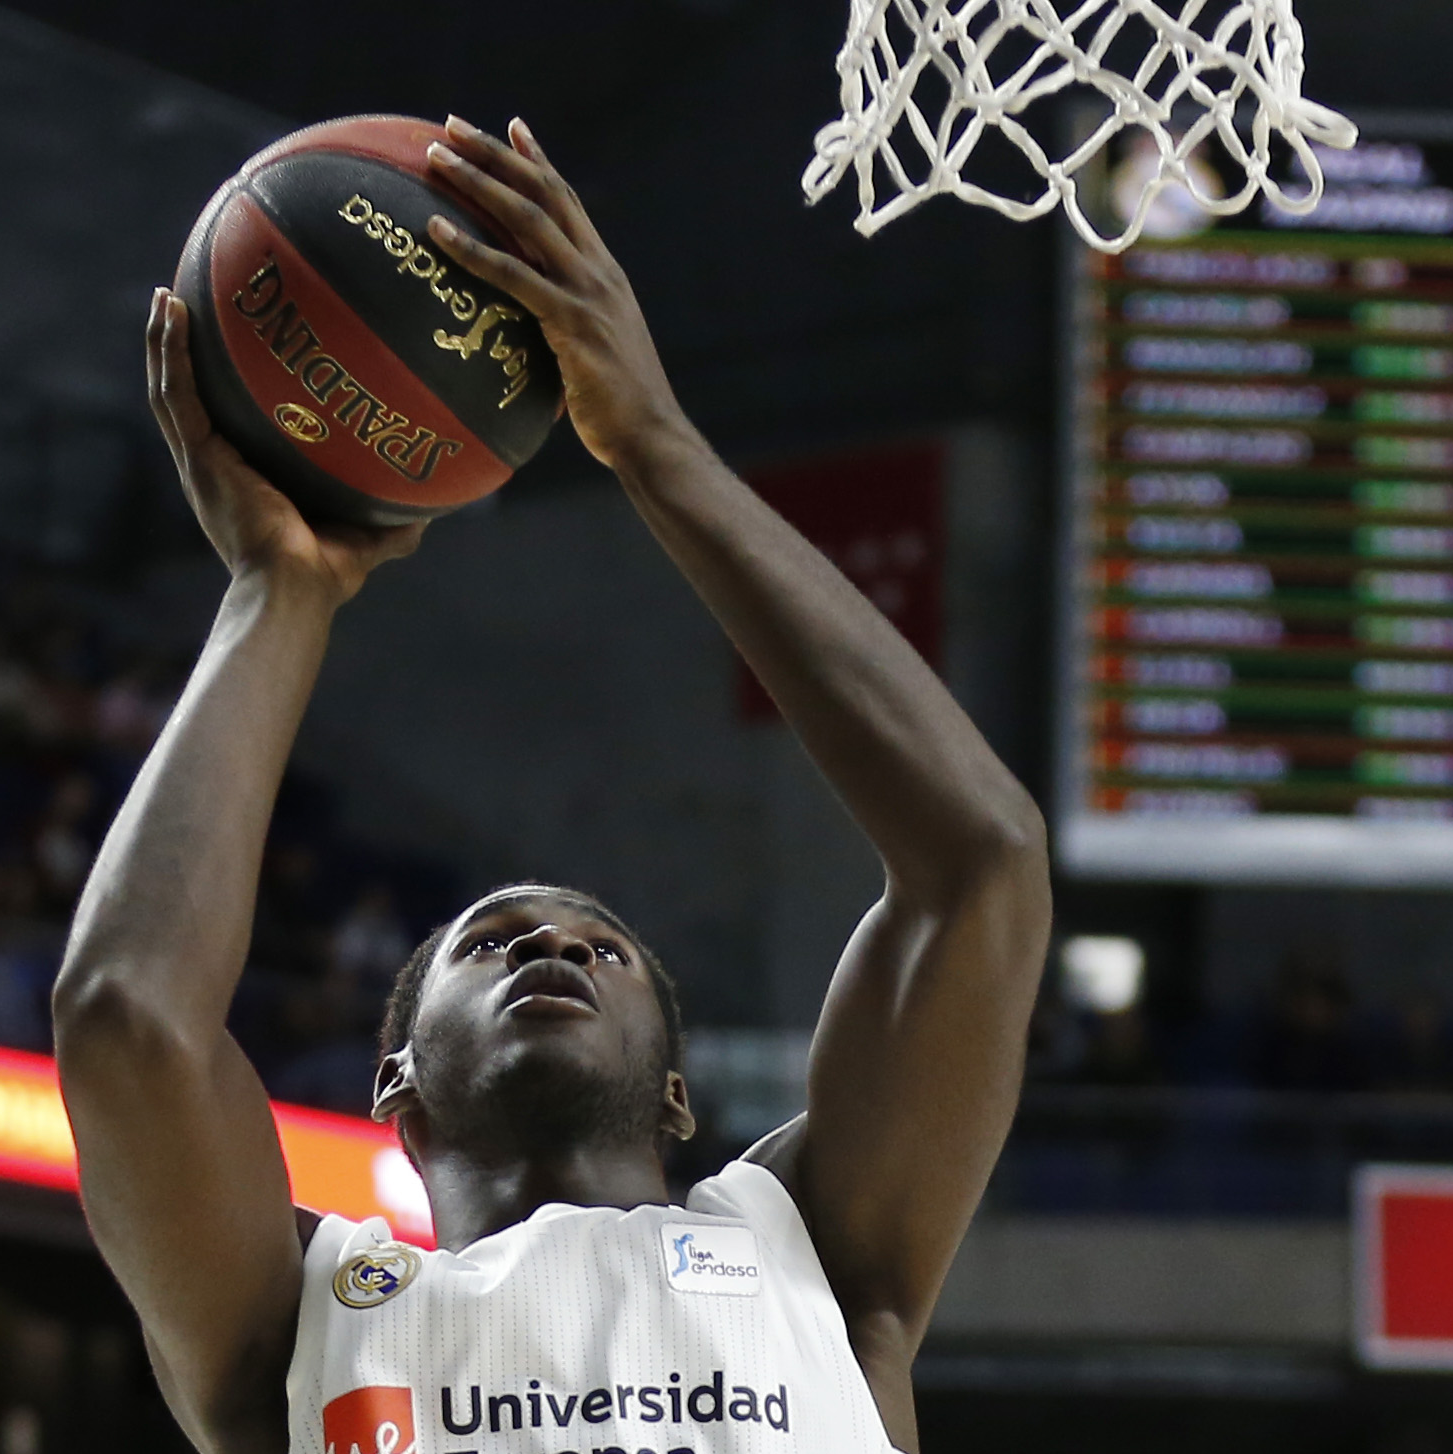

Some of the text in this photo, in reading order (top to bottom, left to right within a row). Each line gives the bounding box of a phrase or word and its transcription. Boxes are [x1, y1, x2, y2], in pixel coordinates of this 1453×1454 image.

[338, 193, 478, 322] endesa
[232, 256, 464, 484] SPALDING
[688, 1243, 714, 1262] liga
[691, 1262, 758, 1277] endesa
[440, 1371, 790, 1436] Universidad
